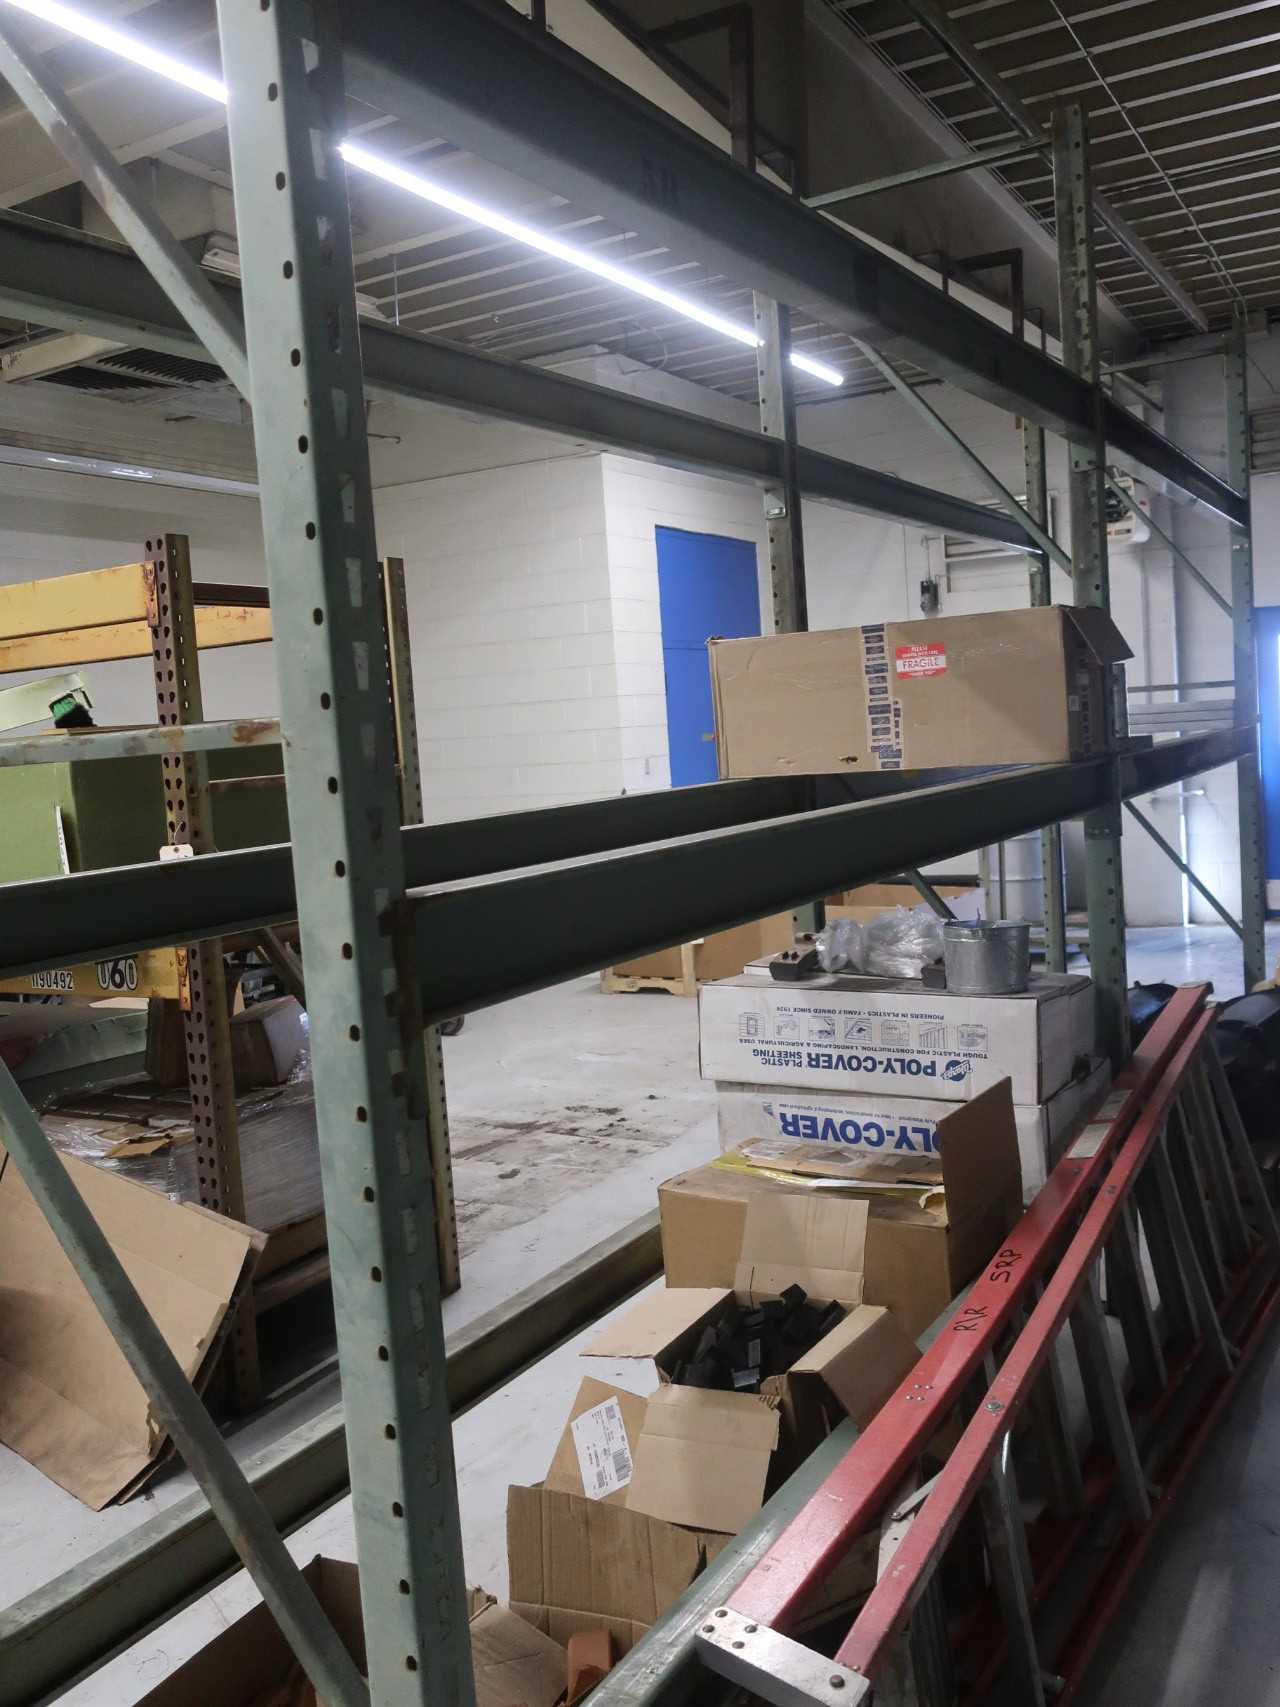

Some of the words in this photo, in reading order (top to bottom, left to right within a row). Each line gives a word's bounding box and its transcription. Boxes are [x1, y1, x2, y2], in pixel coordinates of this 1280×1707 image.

[902, 657, 940, 669] FRAGILE
[837, 1008, 861, 1016] FAMILY
[813, 1042, 859, 1050] LANDSCAPING
[752, 1048, 802, 1059] SHEETING
[933, 1050, 960, 1058] PLASTIC
[761, 1057, 802, 1068] PLASTIC
[807, 1052, 937, 1077] POLY-COVER
[779, 1112, 939, 1152] LY-COVER
